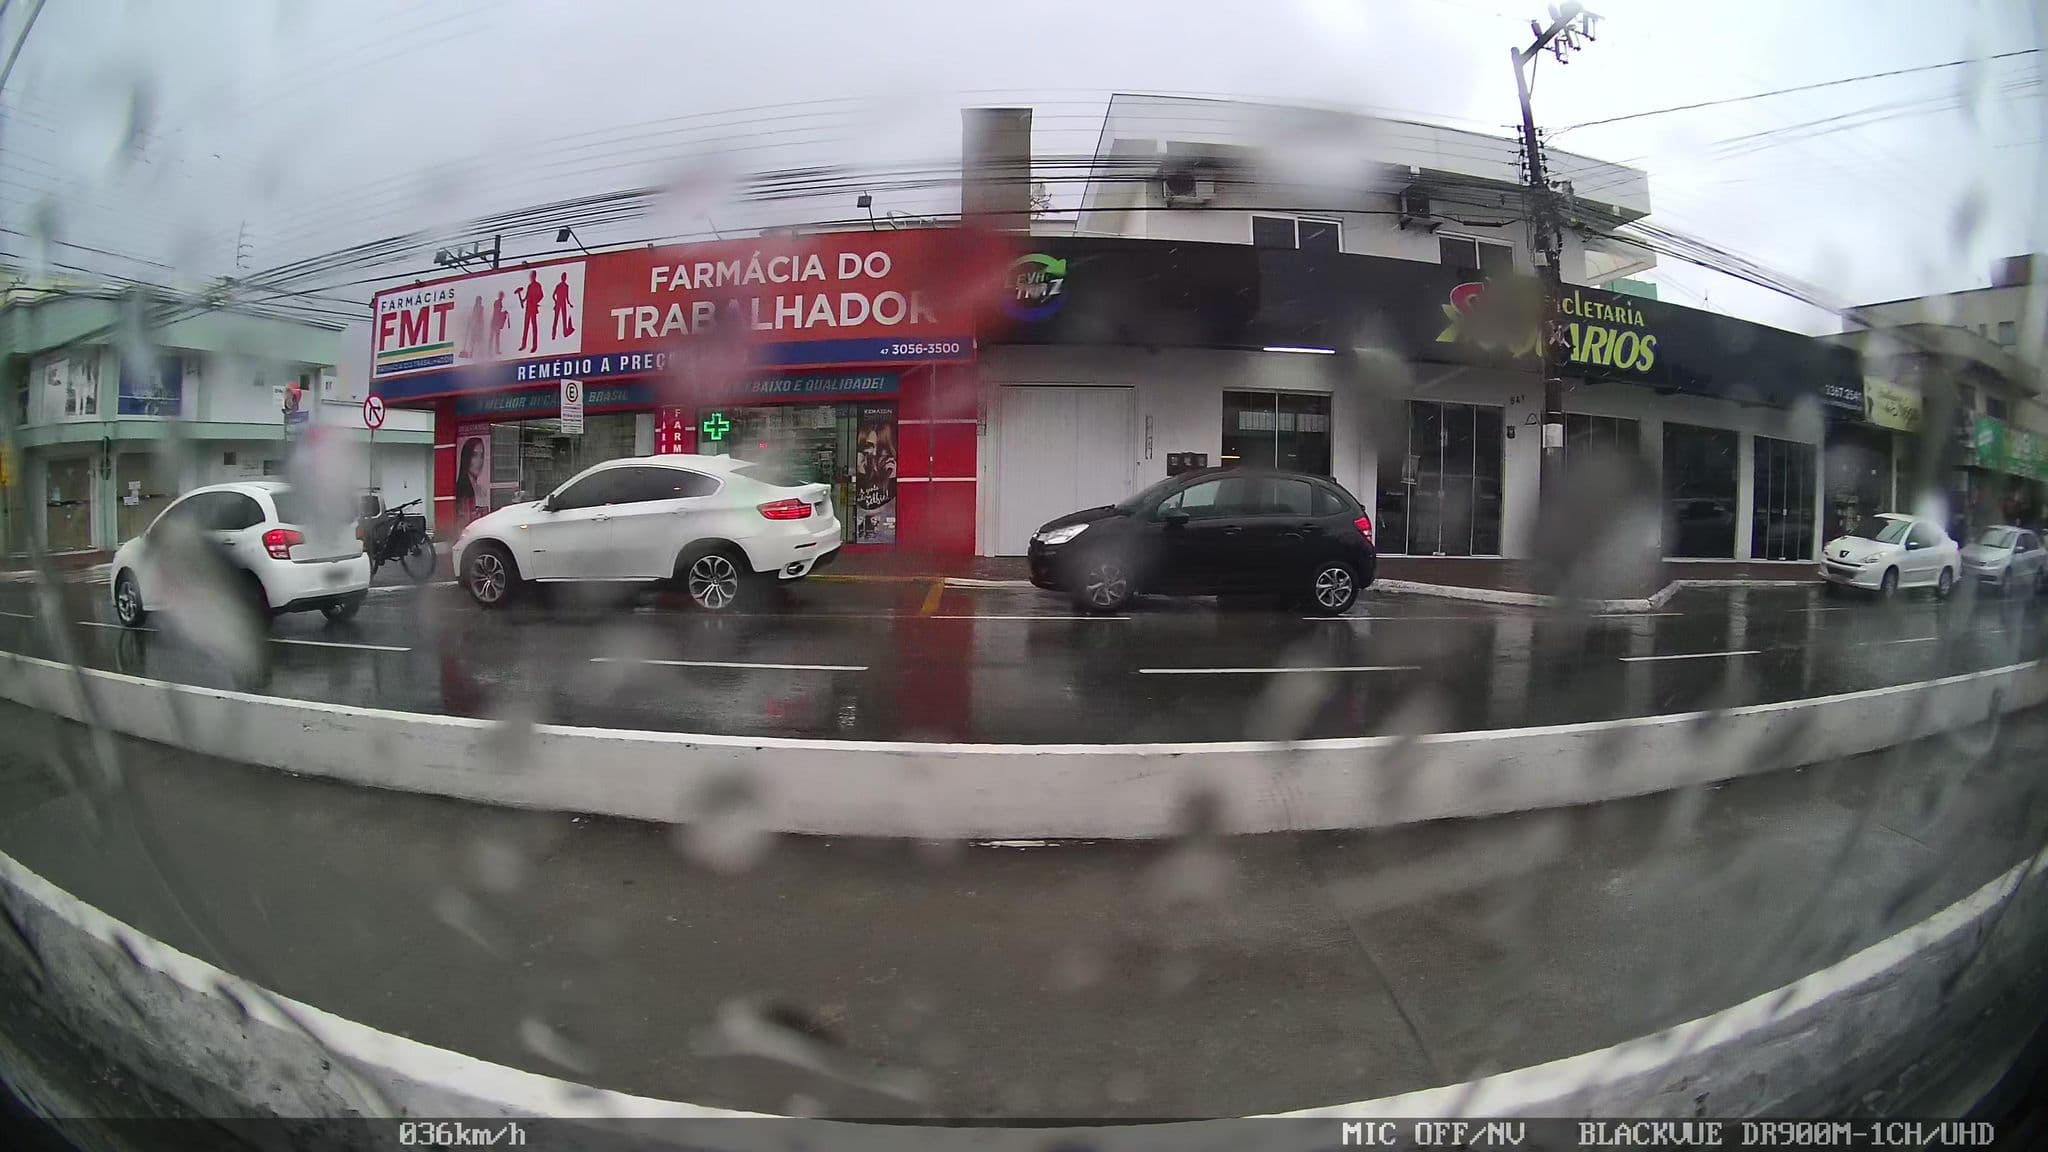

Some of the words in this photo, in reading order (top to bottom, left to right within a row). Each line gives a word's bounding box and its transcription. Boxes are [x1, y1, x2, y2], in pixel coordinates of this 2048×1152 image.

[649, 250, 826, 293] FARMÁCIA
[837, 250, 892, 280] DO
[379, 301, 455, 352] FMT
[610, 290, 938, 341] TRABLHADOR
[1561, 289, 1645, 327] CLETARIA
[517, 354, 592, 382] REMÉDIO
[600, 356, 610, 373] A
[620, 351, 667, 371] PREÇ
[891, 342, 961, 356] 3056-3500
[1569, 322, 1658, 373] ARIOS
[793, 378, 804, 391] E
[805, 376, 885, 393] QUALIDADE!
